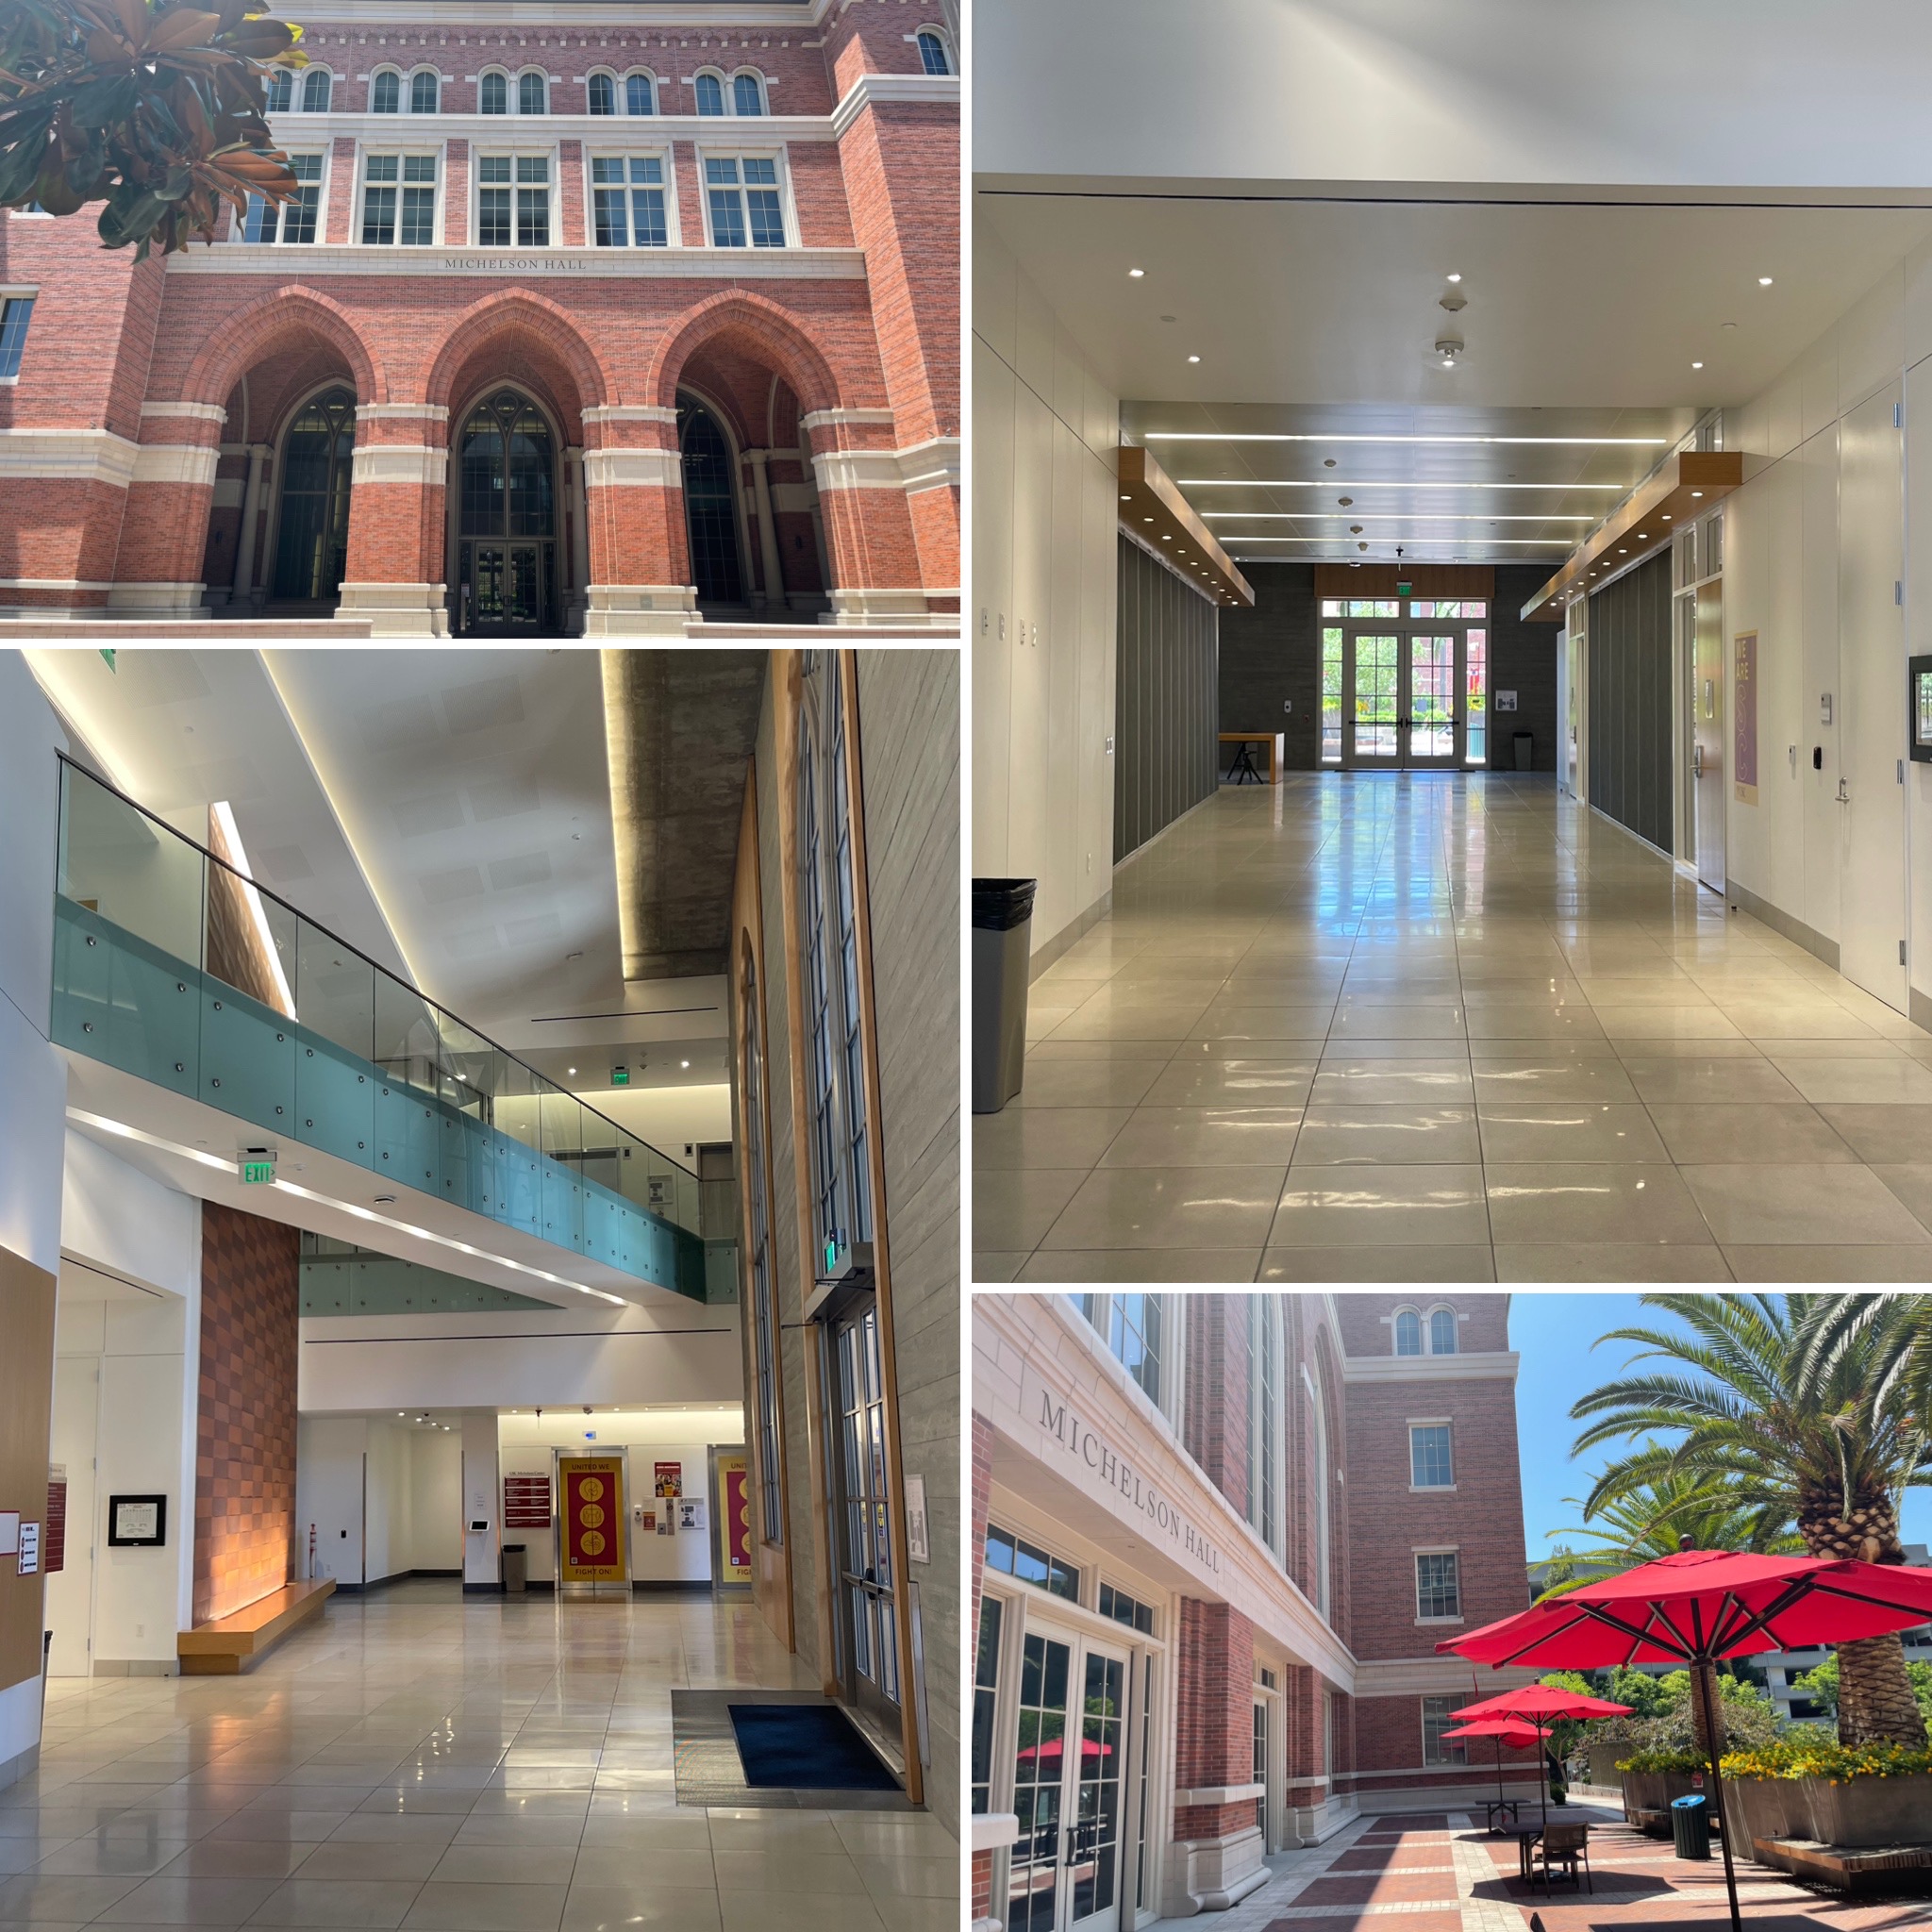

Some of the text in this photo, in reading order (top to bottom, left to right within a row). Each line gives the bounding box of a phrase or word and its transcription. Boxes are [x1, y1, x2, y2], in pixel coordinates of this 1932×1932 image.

[444, 258, 587, 270] MICHELSON HALL
[1736, 641, 1746, 658] WE
[1736, 662, 1749, 680] ARE
[244, 1162, 272, 1183] EXIT
[1039, 1390, 1220, 1574] MICHELSON HALL
